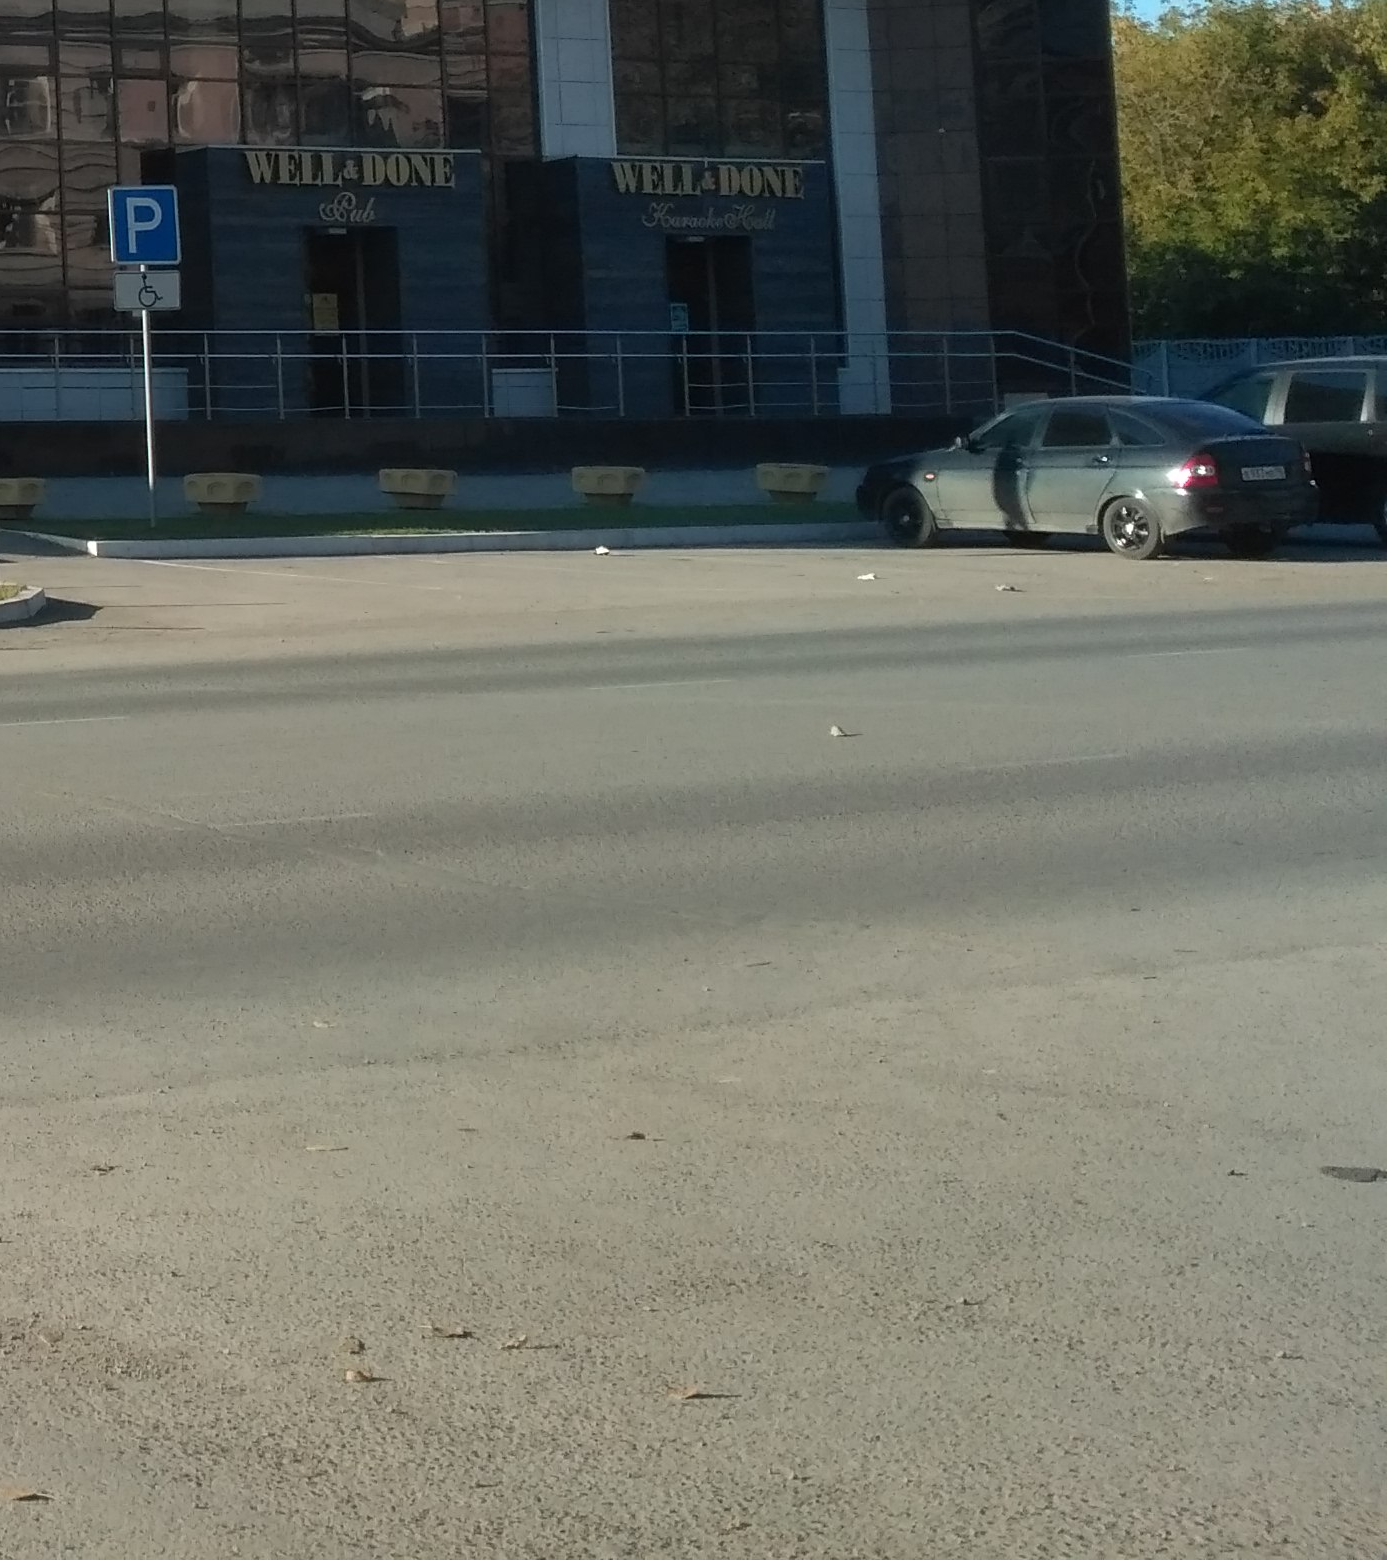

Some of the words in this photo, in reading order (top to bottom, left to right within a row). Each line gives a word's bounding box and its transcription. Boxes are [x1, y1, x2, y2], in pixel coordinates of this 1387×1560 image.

[319, 192, 376, 223] Pub
[642, 202, 724, 229] Karaoke
[724, 204, 776, 231] Hall
[126, 197, 163, 254] P
